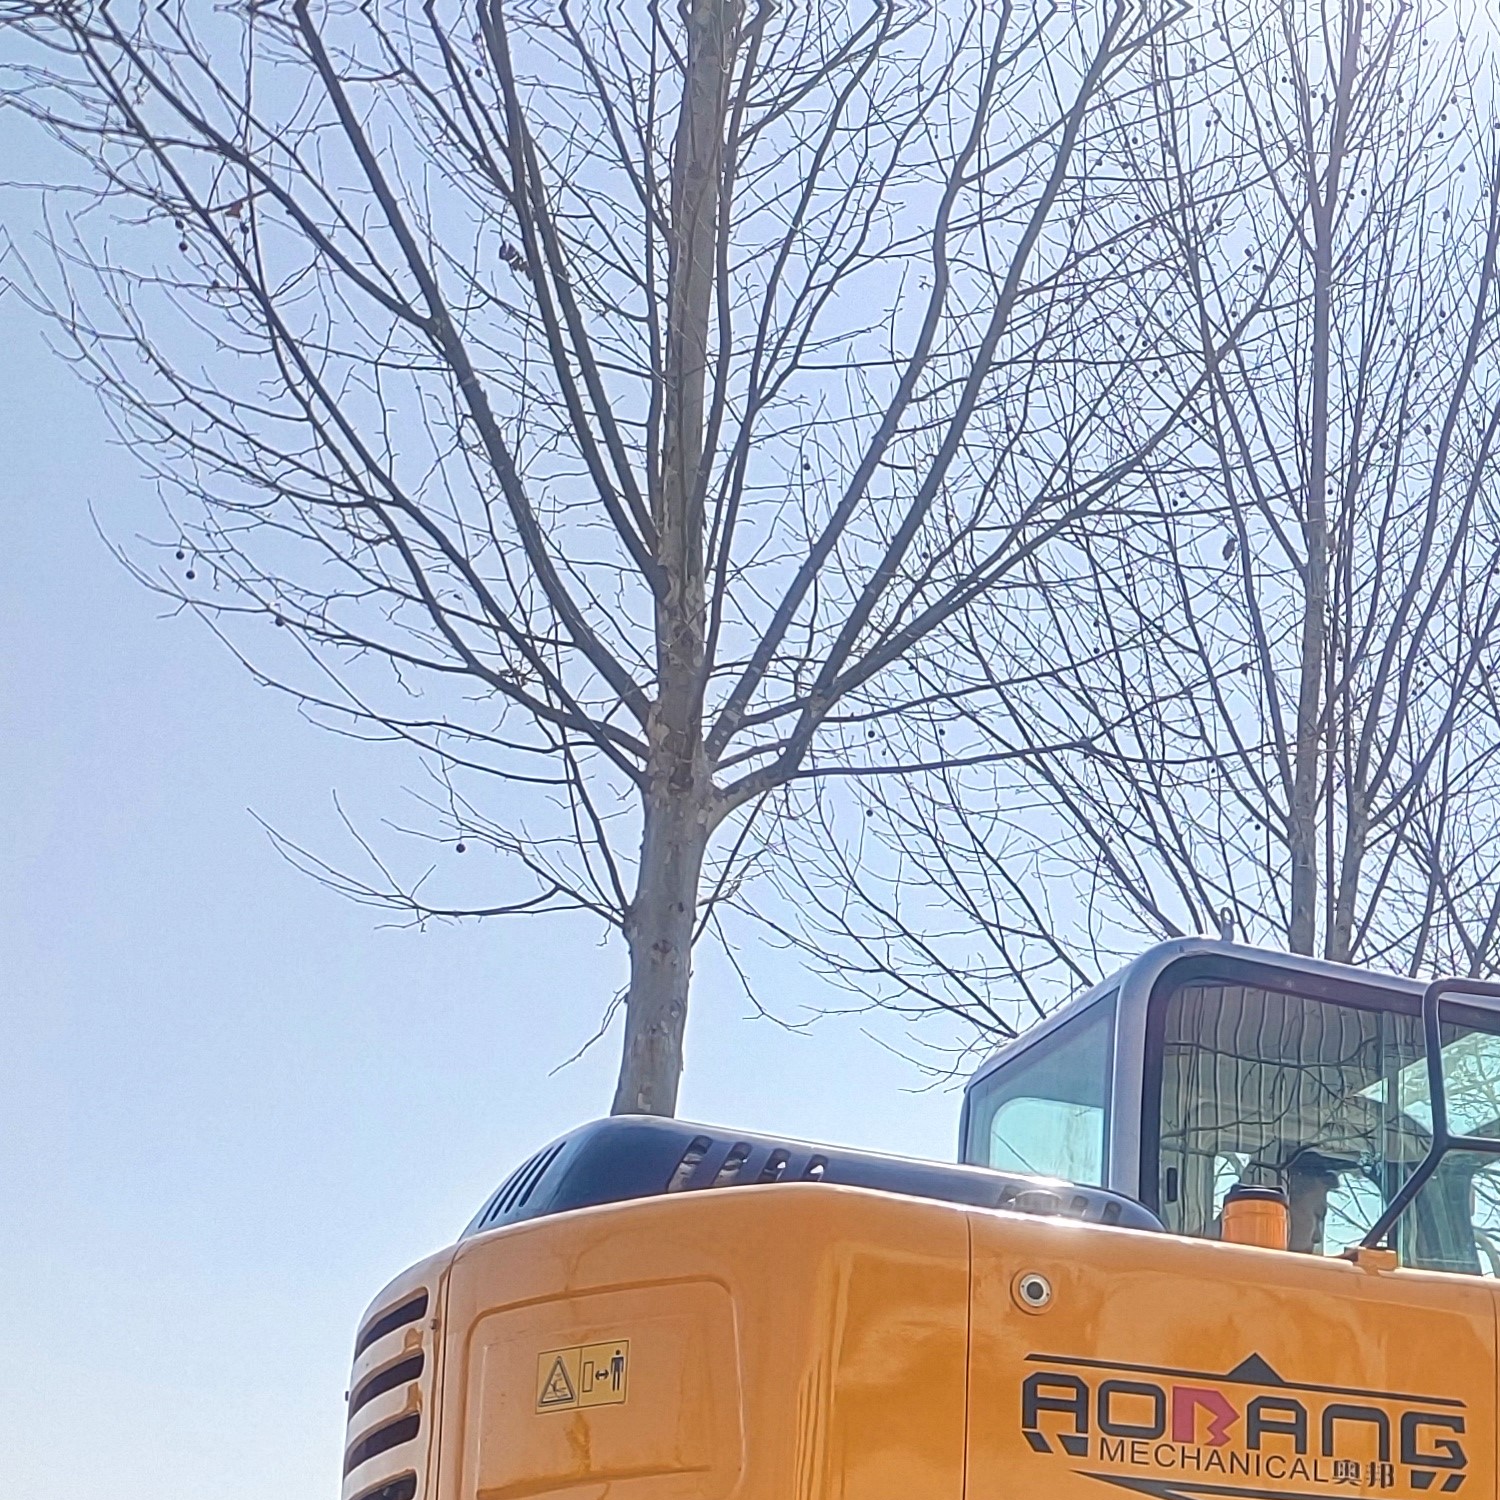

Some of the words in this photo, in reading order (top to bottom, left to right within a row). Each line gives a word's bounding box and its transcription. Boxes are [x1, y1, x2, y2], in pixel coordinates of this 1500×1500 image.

[1022, 1371, 1469, 1492] AOBANG
[1099, 1435, 1330, 1484] MECHANICAL
[1332, 1459, 1396, 1489] 奥邦
